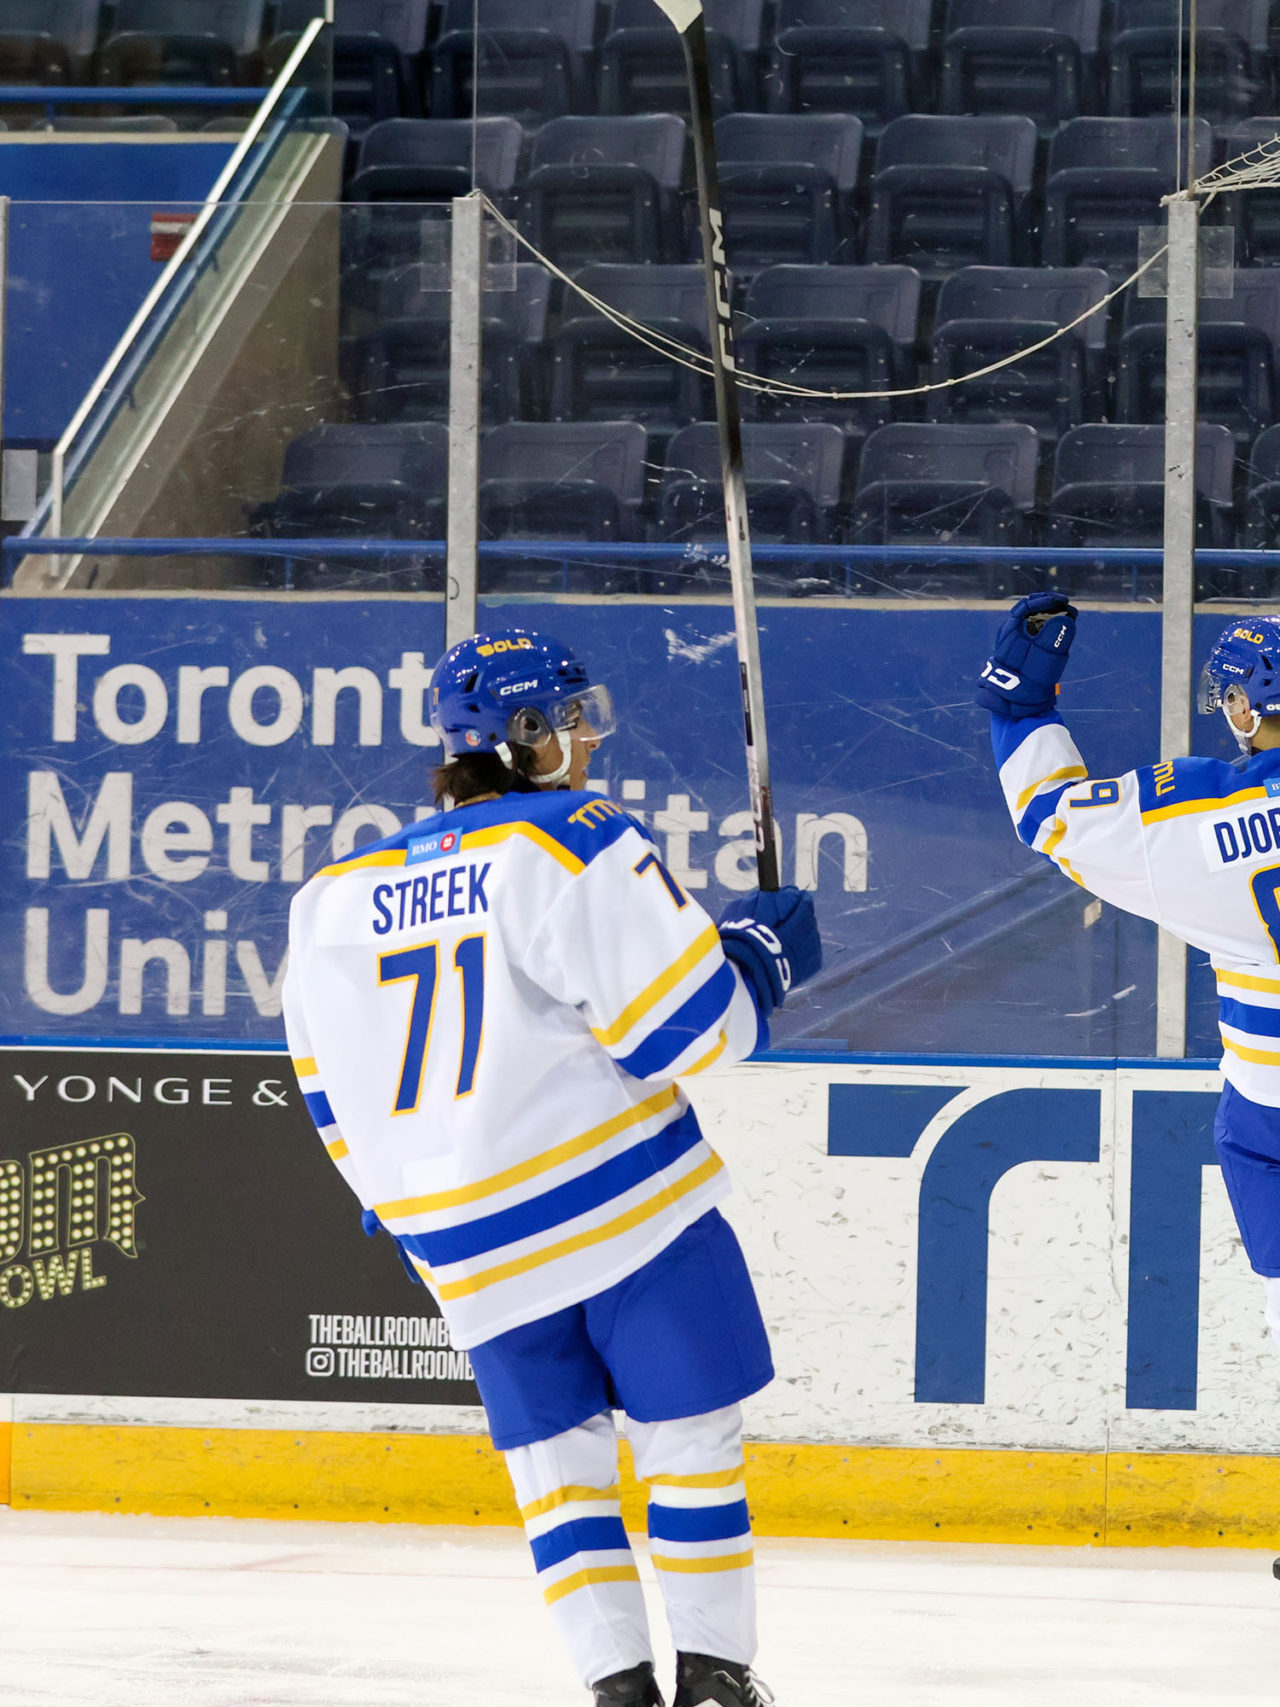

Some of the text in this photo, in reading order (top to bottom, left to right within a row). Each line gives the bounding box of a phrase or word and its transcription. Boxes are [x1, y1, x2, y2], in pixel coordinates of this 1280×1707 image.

[1054, 625, 1067, 648] CCM
[1222, 663, 1244, 676] CCM
[500, 679, 538, 696] CCM
[26, 771, 867, 893] Metrotan
[412, 840, 437, 856] BMO
[372, 862, 492, 935] STREEK
[377, 931, 487, 1117] 71
[13, 1074, 289, 1107] YONGE &
